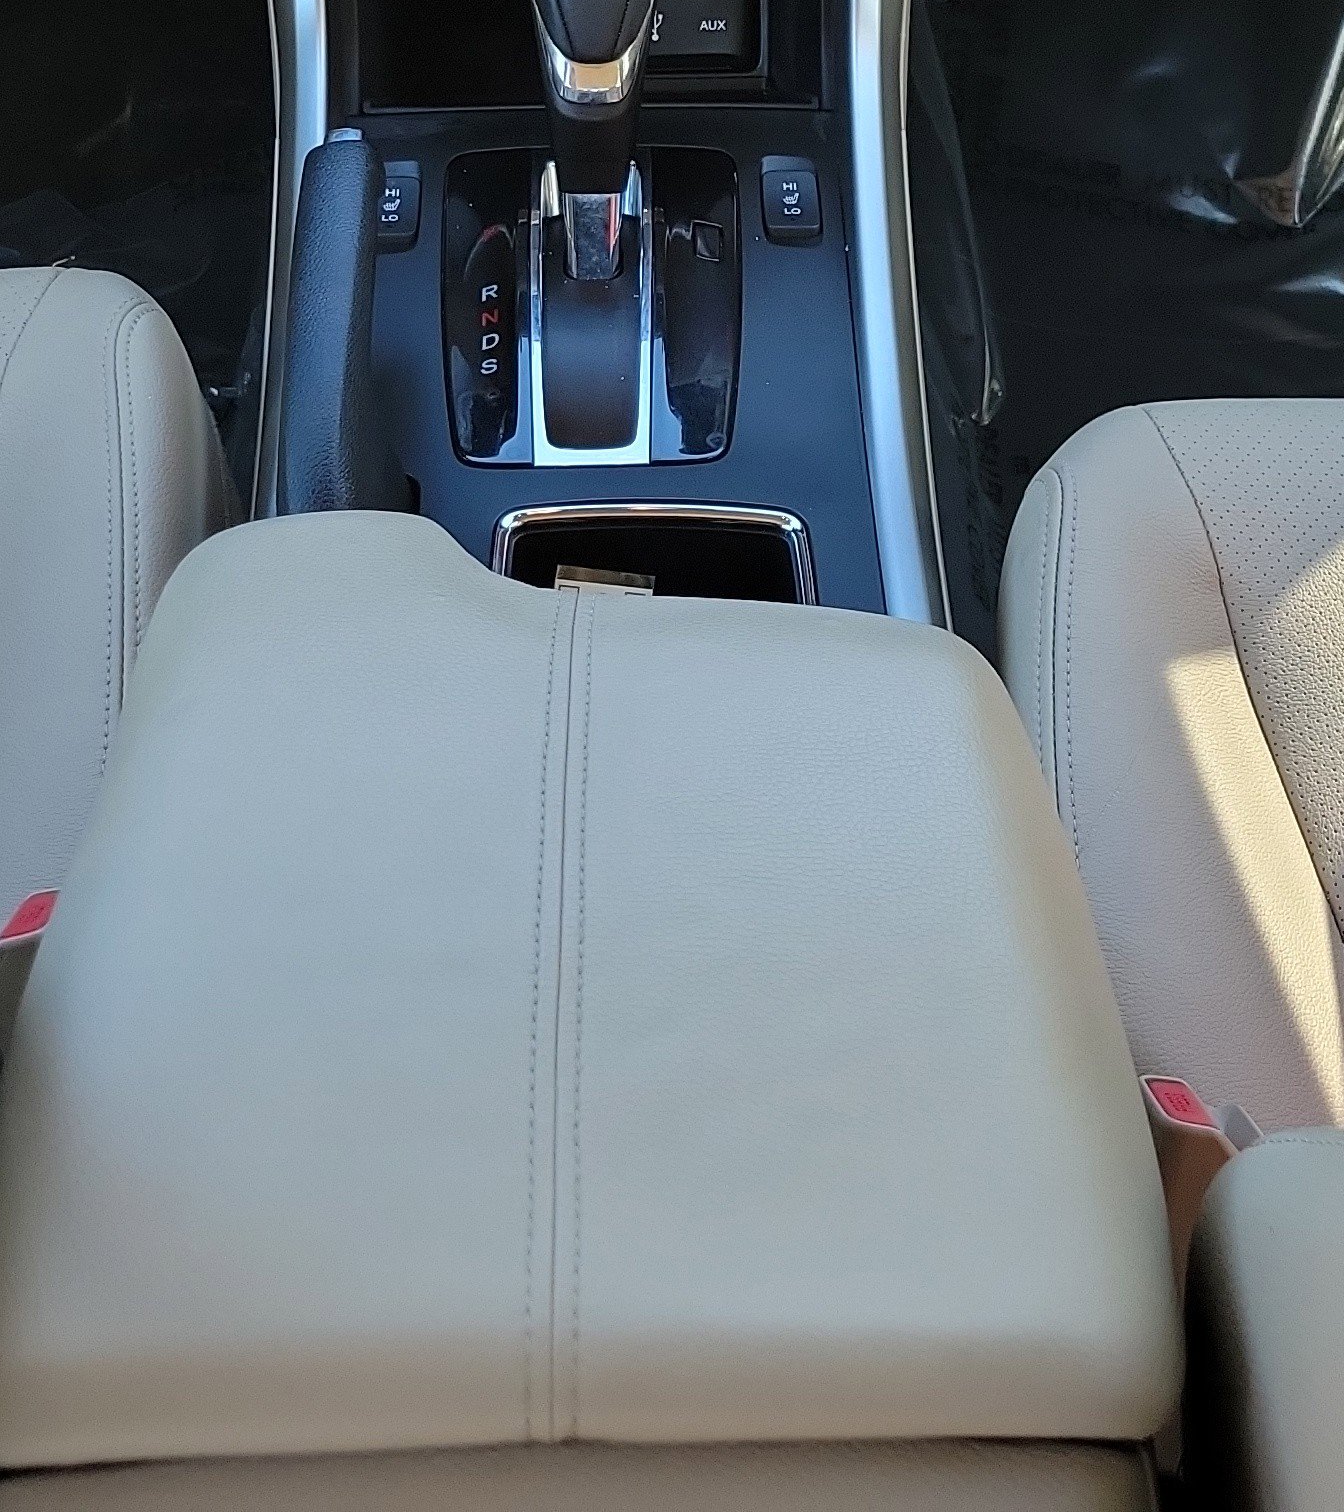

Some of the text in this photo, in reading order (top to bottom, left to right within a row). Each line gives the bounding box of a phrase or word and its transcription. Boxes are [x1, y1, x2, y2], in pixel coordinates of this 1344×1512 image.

[700, 20, 726, 31] AUX
[782, 182, 797, 191] HI
[385, 189, 400, 197] HI
[784, 207, 801, 215] LO
[381, 214, 398, 222] LO
[481, 285, 498, 301] R
[481, 310, 498, 325] N
[481, 334, 499, 350] D
[481, 358, 498, 375] S
